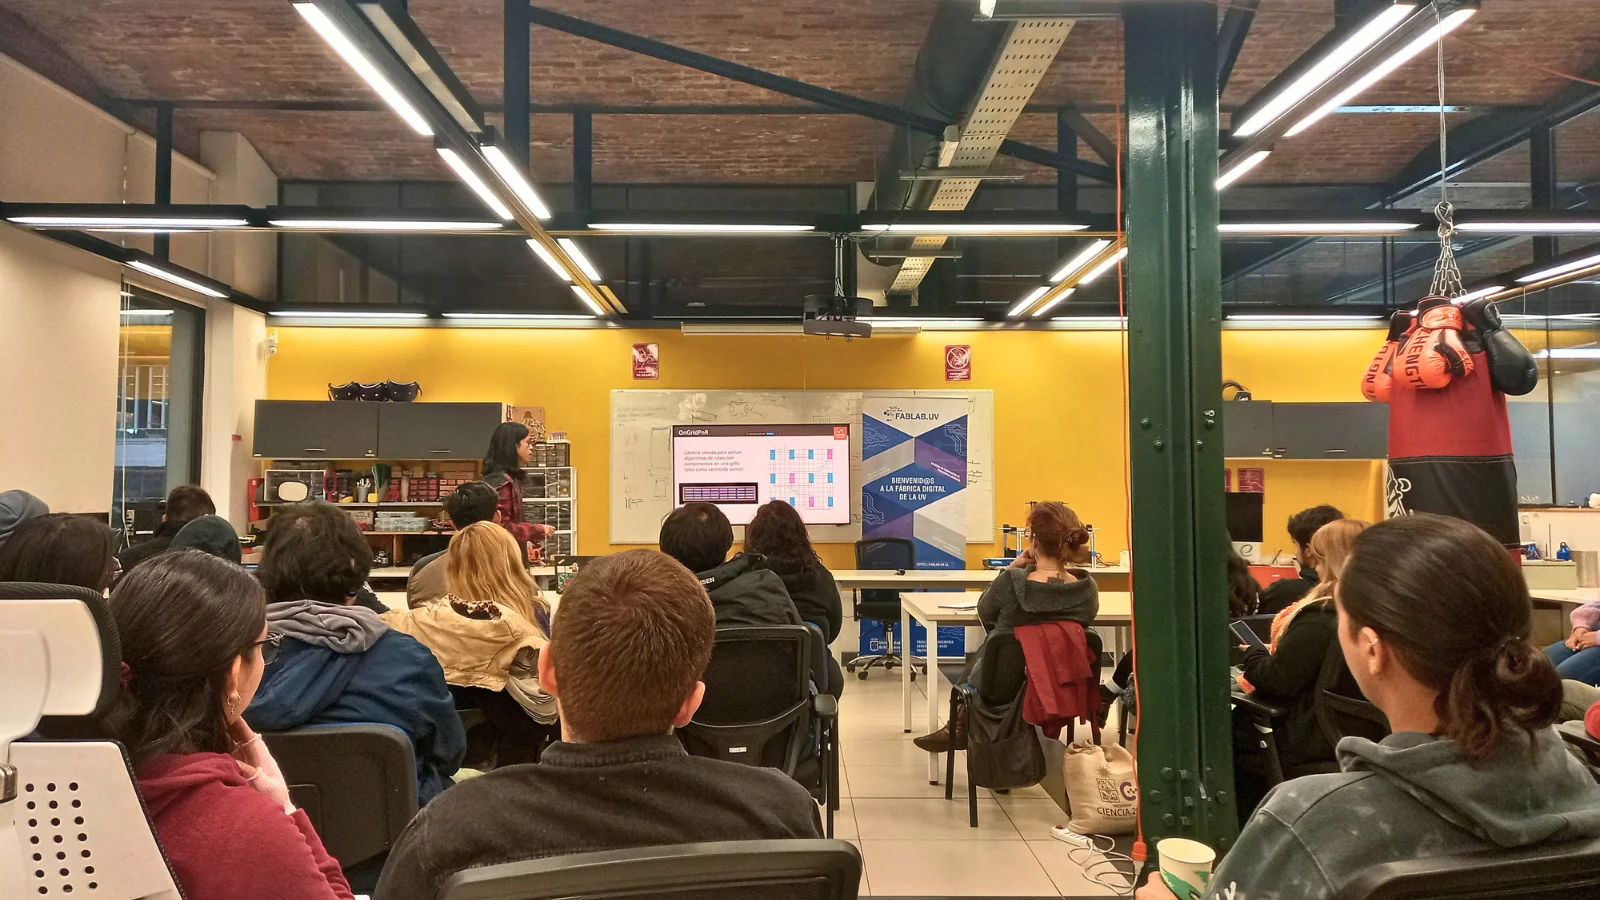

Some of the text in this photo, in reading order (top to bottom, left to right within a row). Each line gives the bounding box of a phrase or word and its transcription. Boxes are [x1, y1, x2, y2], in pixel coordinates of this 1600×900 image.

[895, 412, 940, 420] FABLAB.UV
[891, 477, 935, 485] BIENVENID@S
[922, 485, 946, 493] DIGITAL
[1096, 806, 1131, 816] CIENCIA
